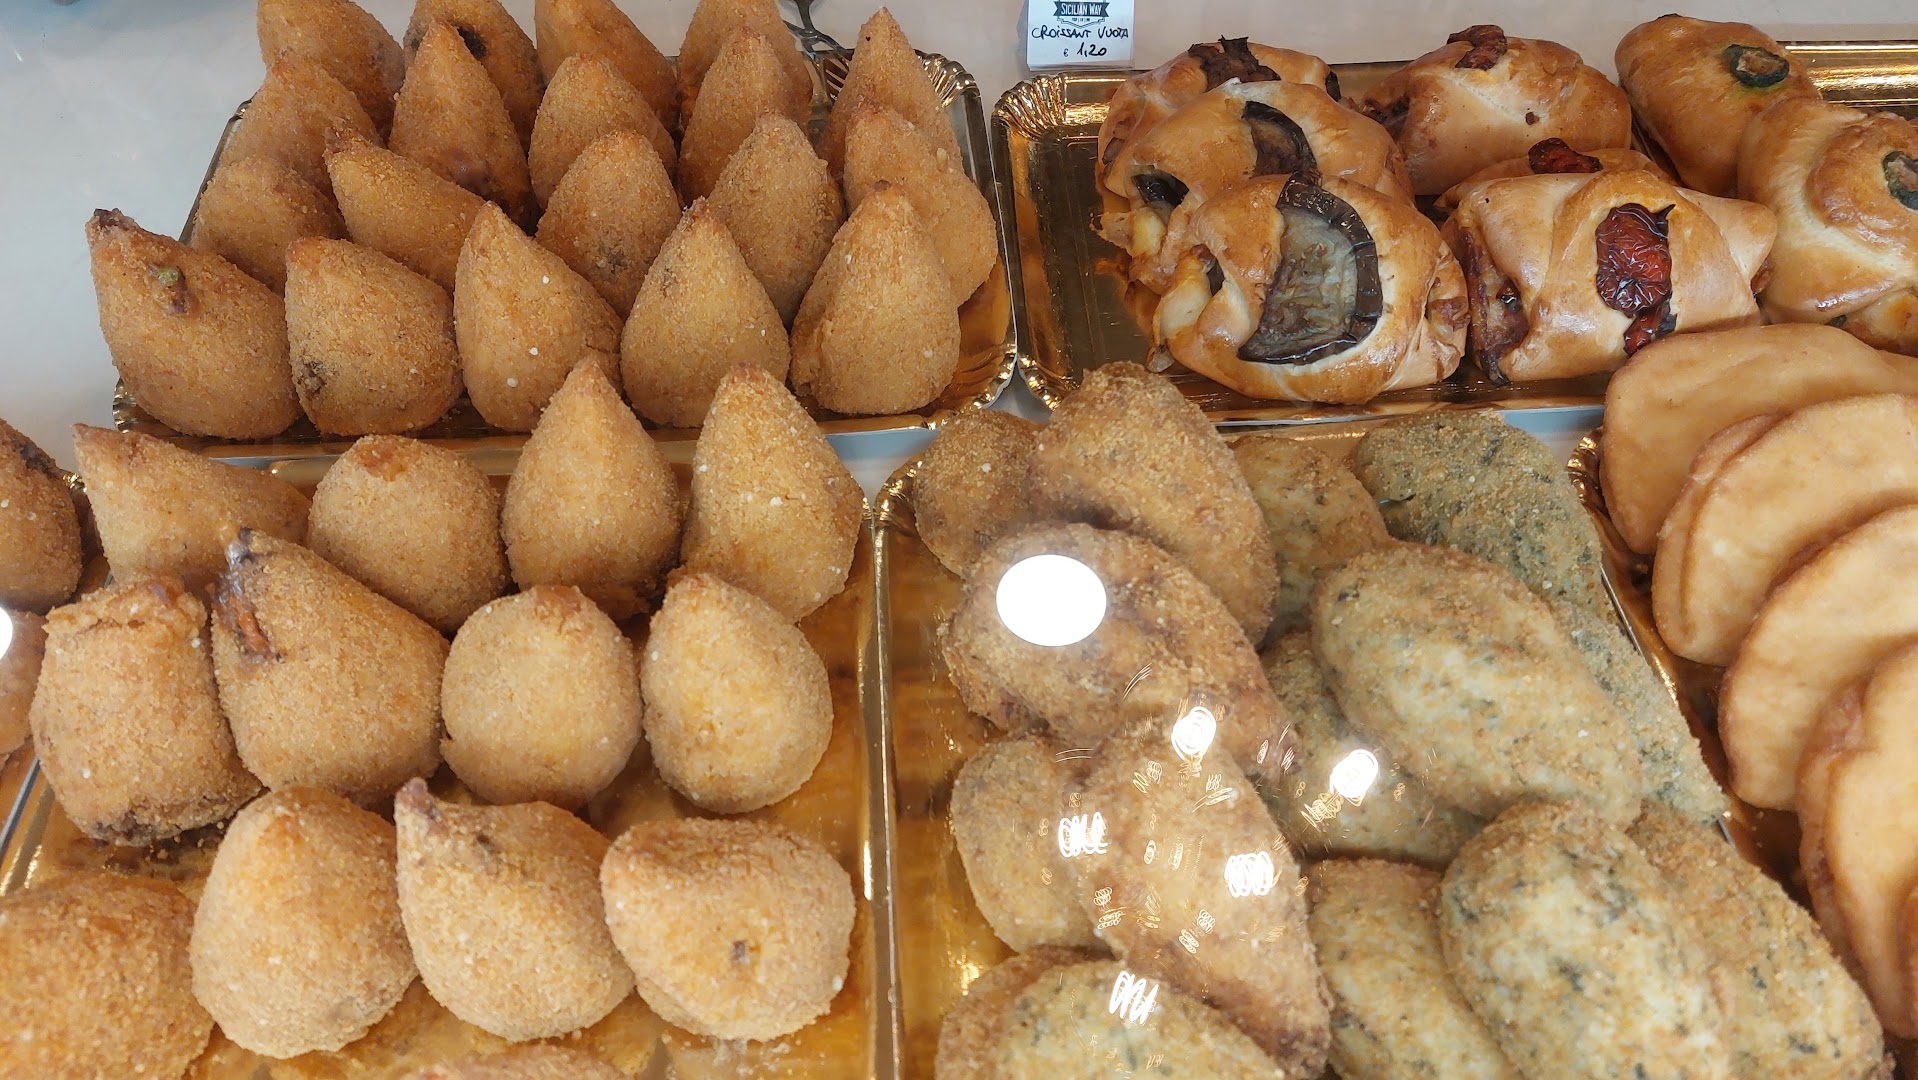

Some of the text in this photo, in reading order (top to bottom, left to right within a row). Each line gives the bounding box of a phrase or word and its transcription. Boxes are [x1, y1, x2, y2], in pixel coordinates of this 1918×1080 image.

[1061, 3, 1102, 15] SICILIAN WAY
[1063, 42, 1107, 57] € 1,20
